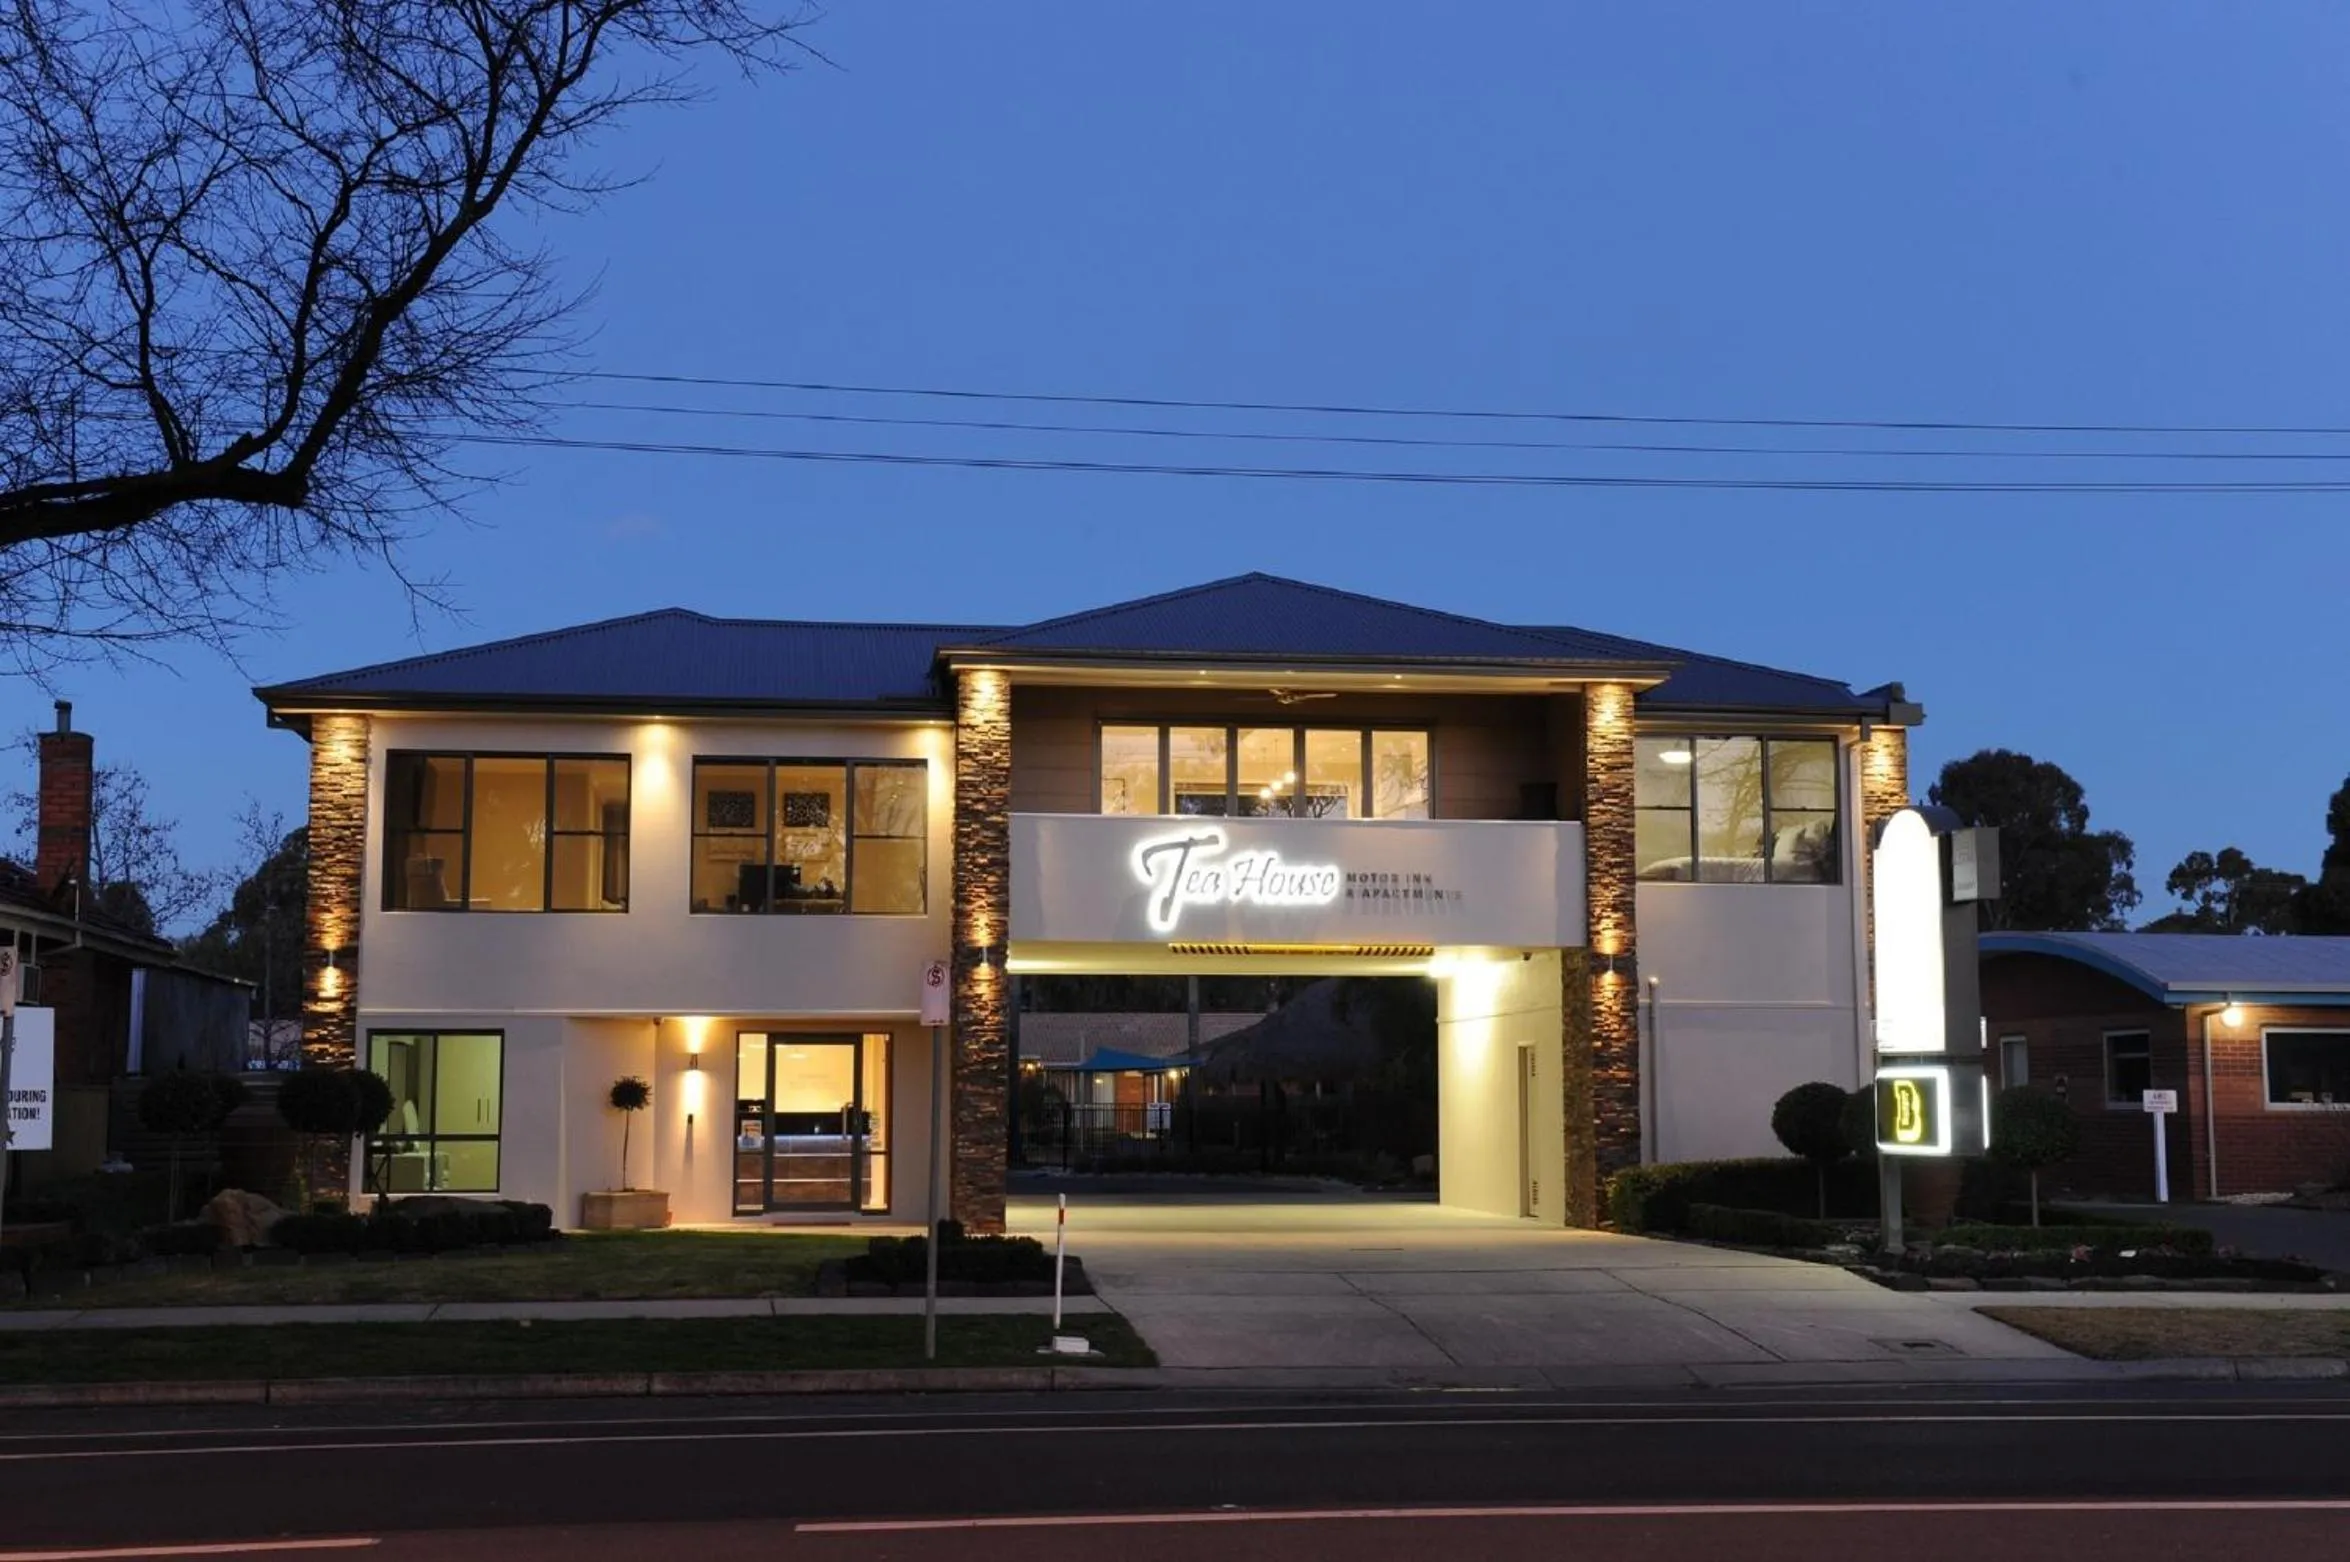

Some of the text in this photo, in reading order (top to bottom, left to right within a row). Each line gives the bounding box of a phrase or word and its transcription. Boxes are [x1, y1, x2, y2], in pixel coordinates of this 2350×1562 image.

[1139, 833, 1336, 924] Tea House
[1404, 872, 1432, 884] INN
